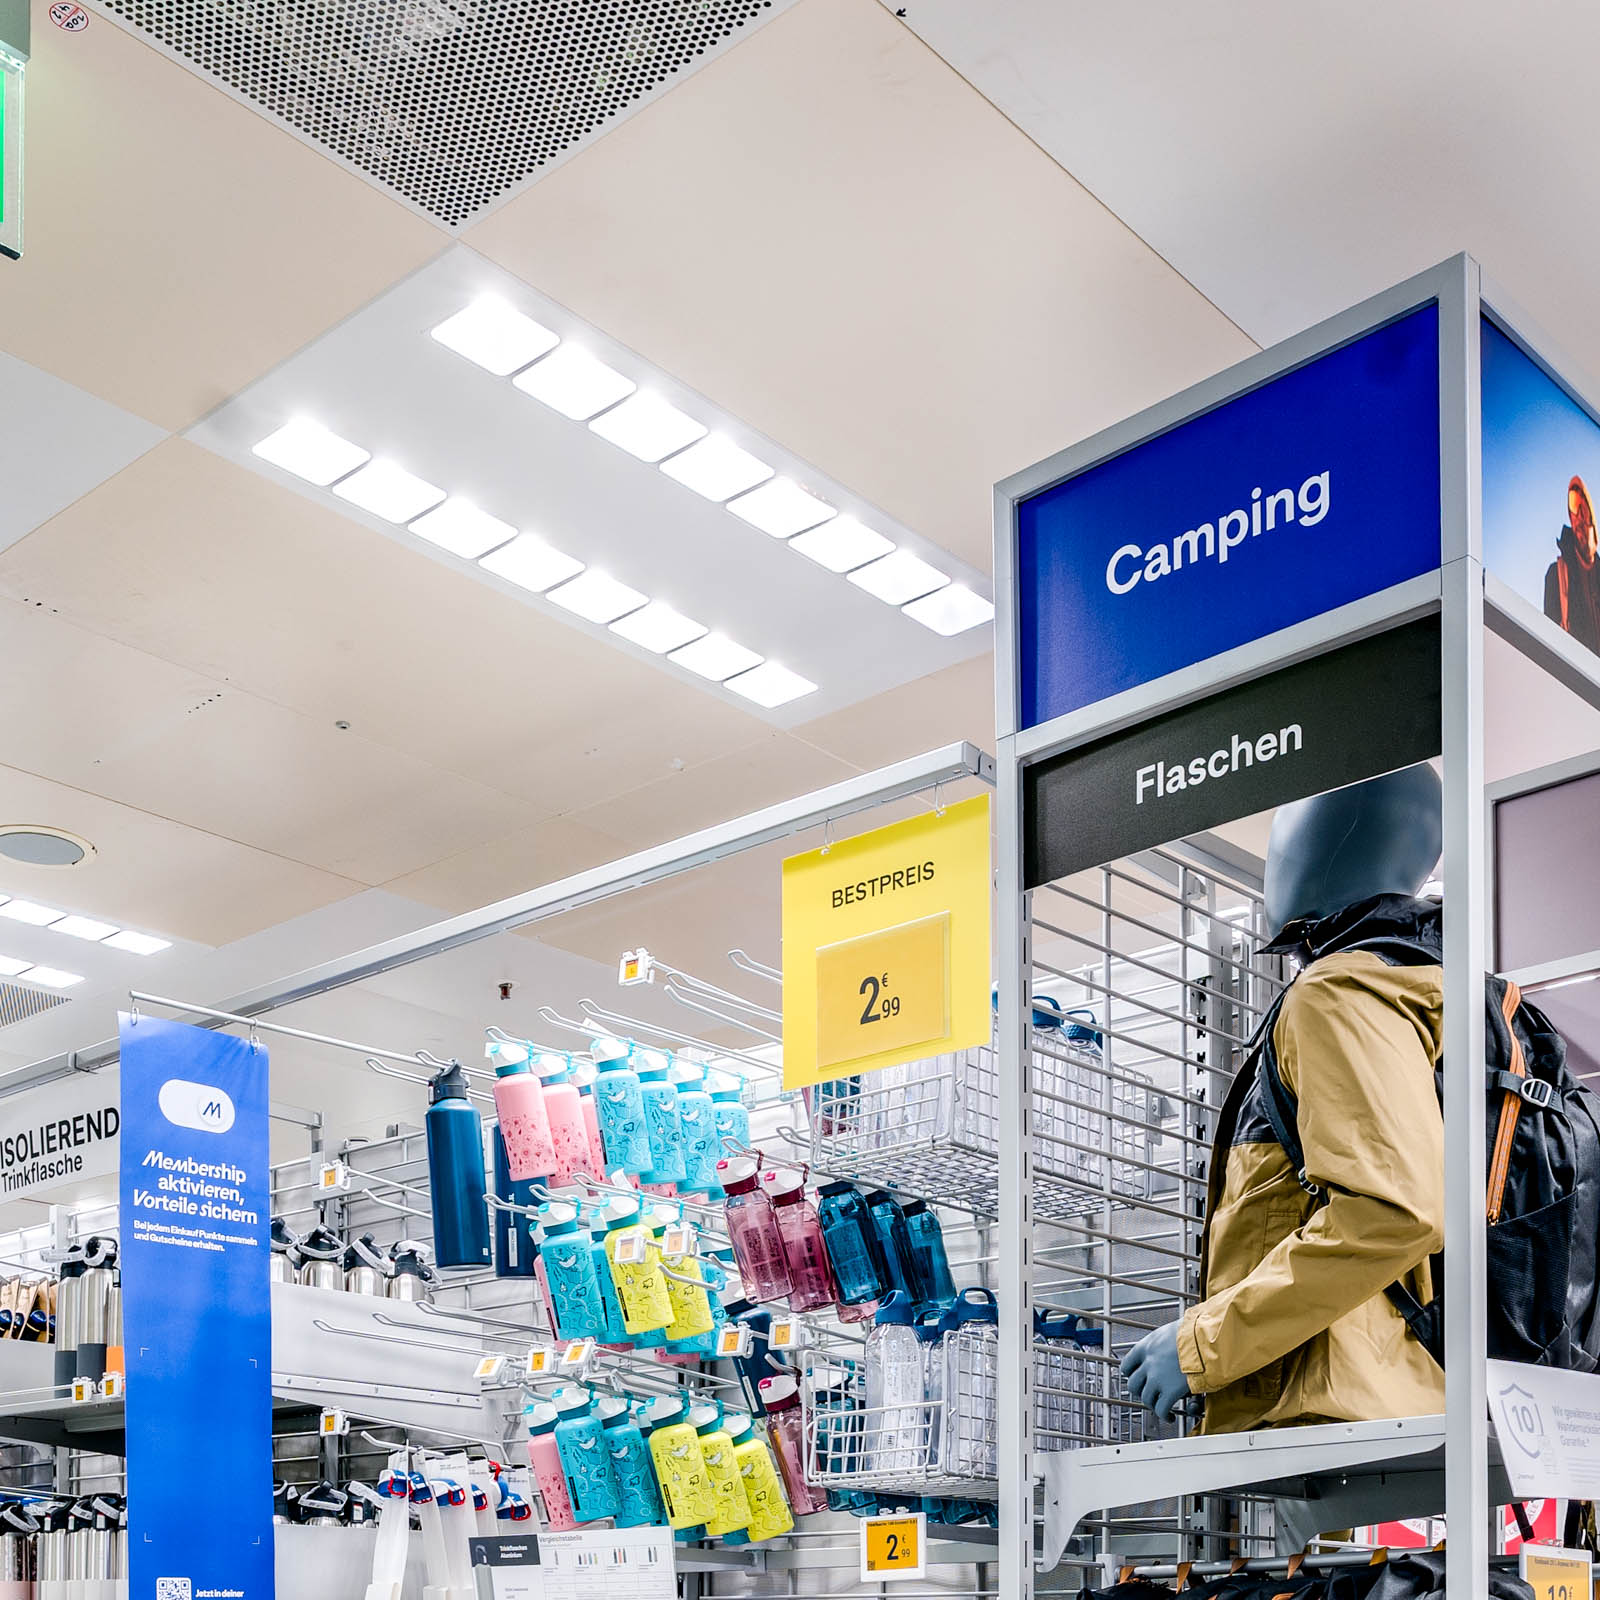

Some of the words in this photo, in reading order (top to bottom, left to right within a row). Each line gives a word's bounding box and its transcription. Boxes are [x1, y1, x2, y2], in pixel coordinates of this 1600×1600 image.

[1106, 470, 1330, 595] Camping
[1136, 723, 1302, 805] Flaschen
[832, 861, 935, 908] BESTPREIS
[1, 1154, 83, 1192] Trinkflasche
[142, 1150, 246, 1186] Membership
[133, 1189, 198, 1215] Vorteile
[200, 1202, 257, 1224] sichern
[158, 1174, 244, 1206] aktivieren,
[134, 1220, 146, 1229] Bei
[146, 1222, 170, 1234] jedem
[171, 1225, 199, 1237] Einkauf
[199, 1230, 225, 1241] Punkte
[134, 1232, 149, 1241] und
[150, 1233, 192, 1247] Gutscheine
[1512, 1405, 1534, 1433] 10
[195, 1589, 214, 1598] Jetzt
[215, 1589, 221, 1597] in
[222, 1589, 244, 1598] deiner
